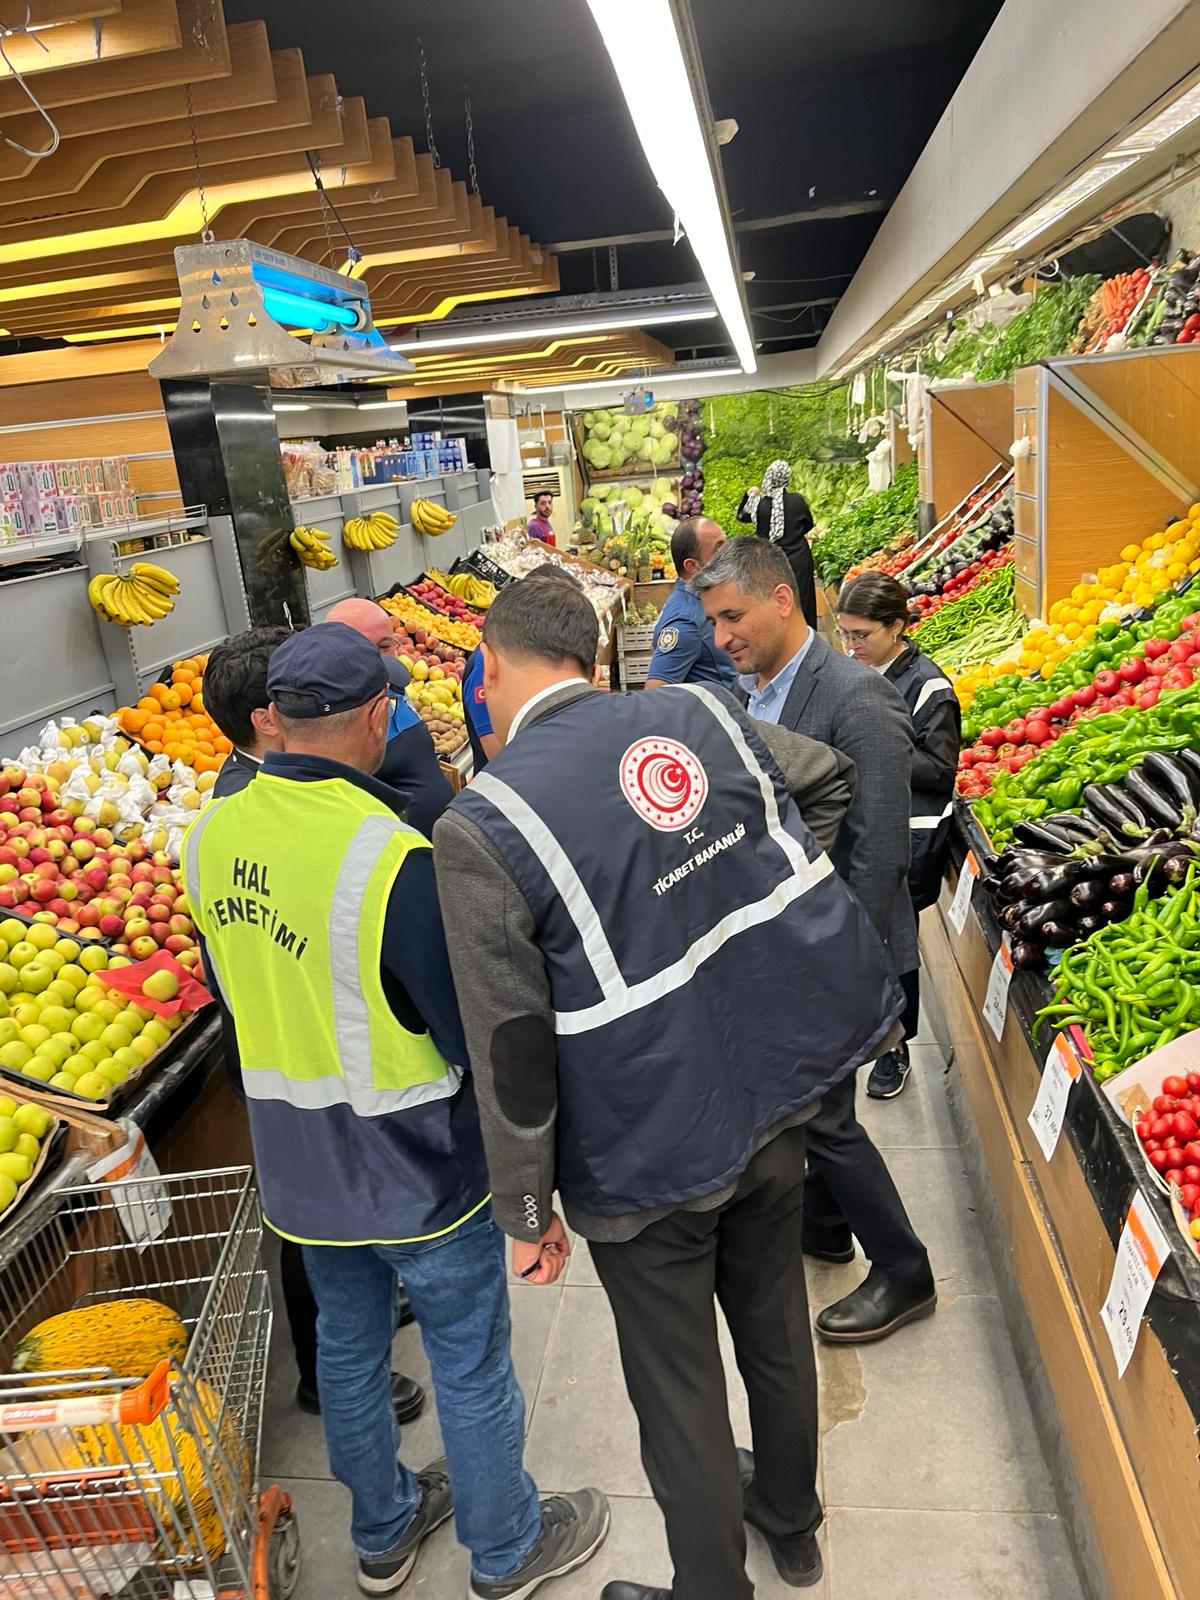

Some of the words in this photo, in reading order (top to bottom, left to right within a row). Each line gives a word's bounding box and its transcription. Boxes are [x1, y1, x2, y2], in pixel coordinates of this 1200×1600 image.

[683, 827, 704, 846] T.C.
[233, 857, 271, 897] HAL
[652, 858, 695, 896] TİCARET
[694, 823, 746, 866] BAKANLIĞI
